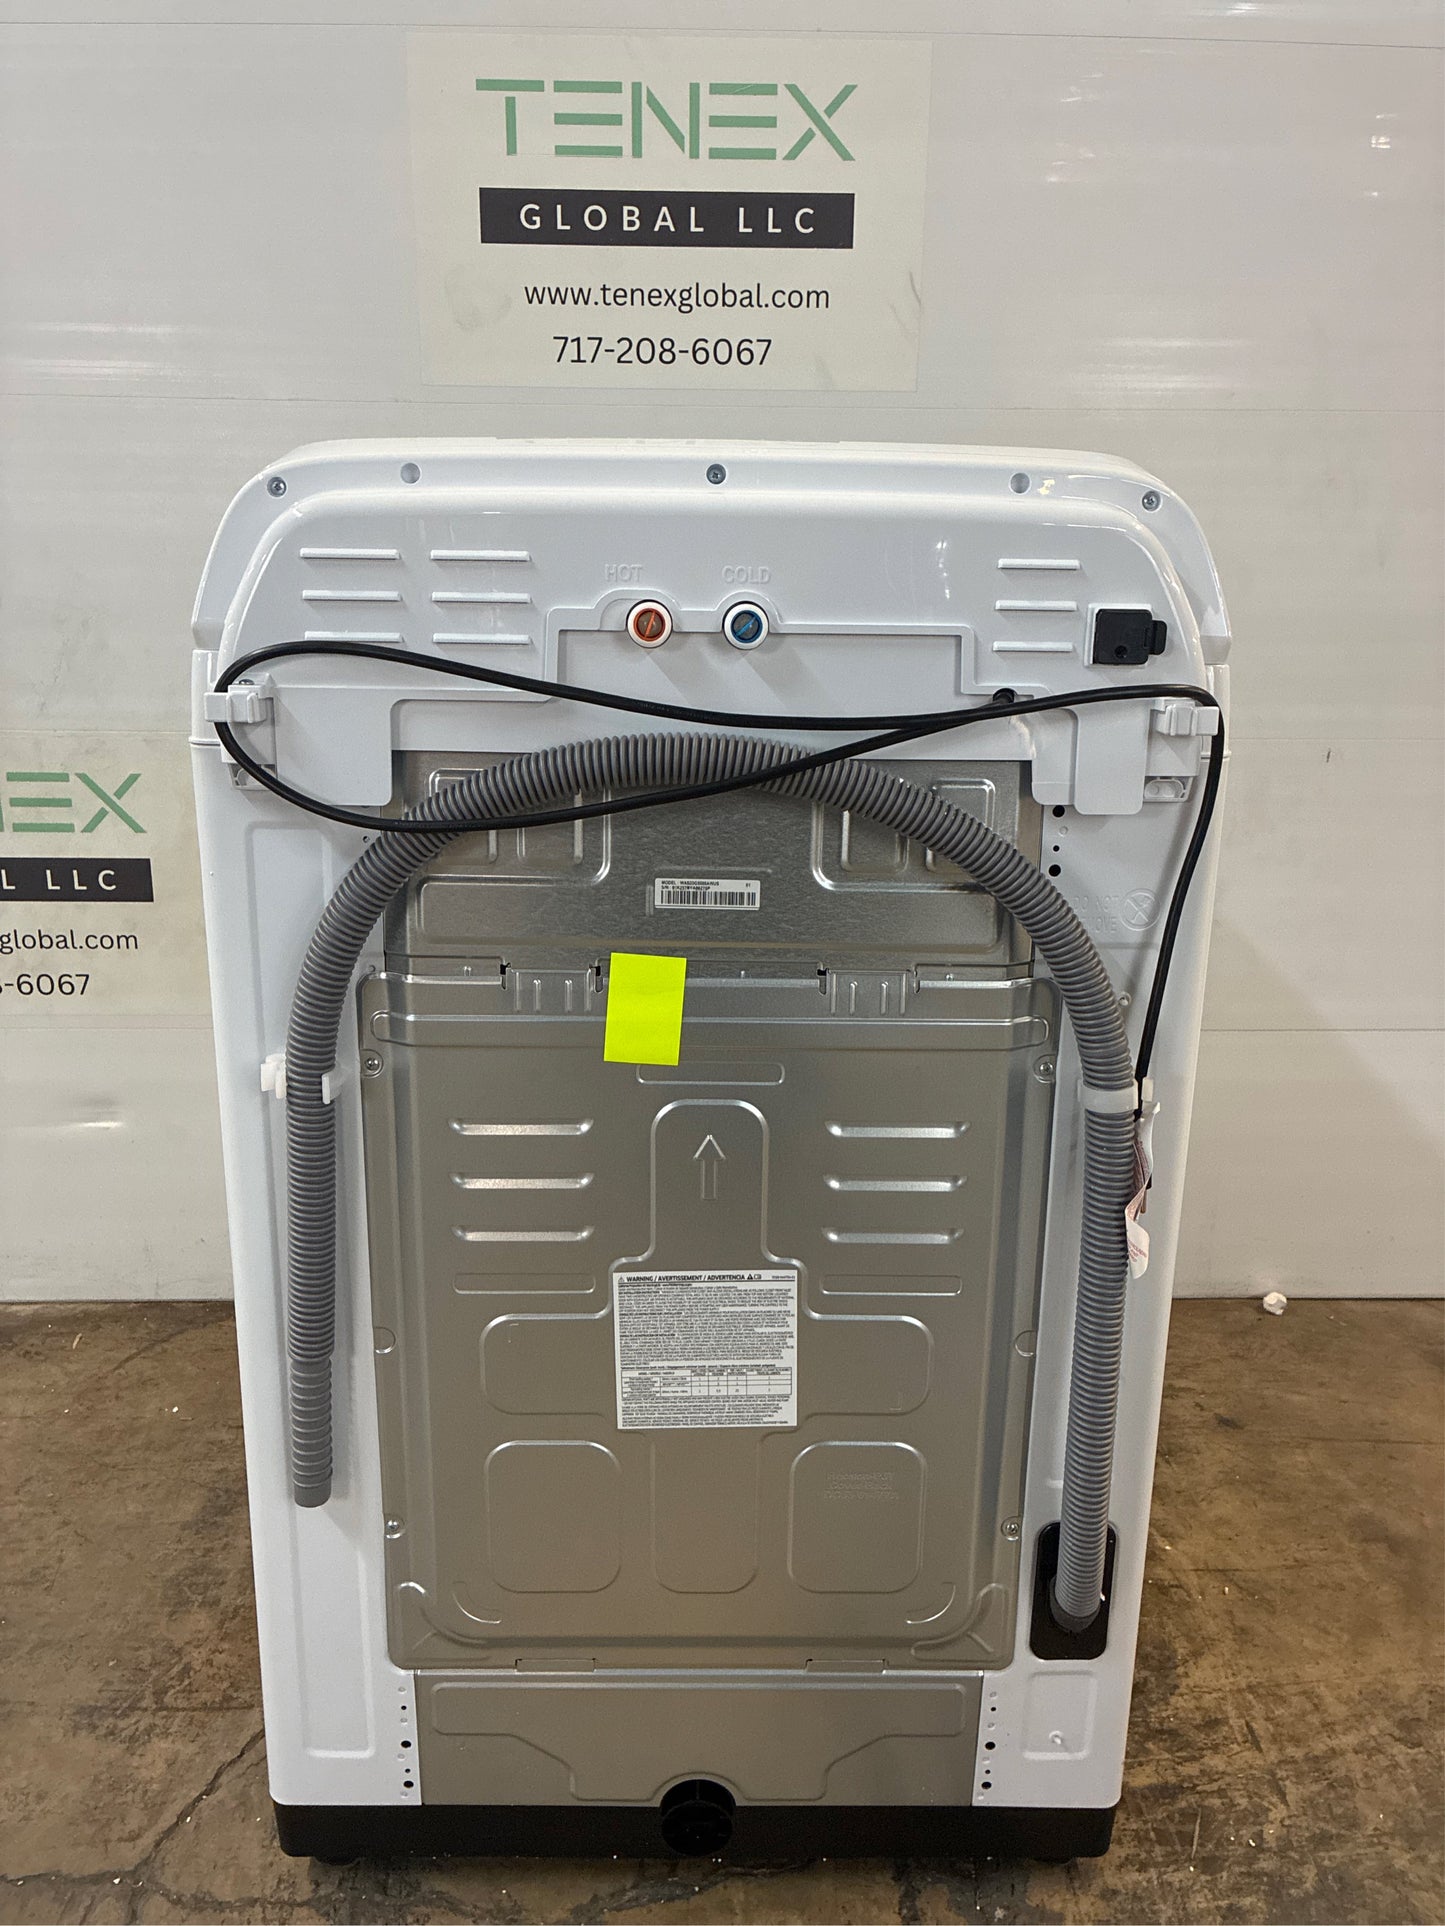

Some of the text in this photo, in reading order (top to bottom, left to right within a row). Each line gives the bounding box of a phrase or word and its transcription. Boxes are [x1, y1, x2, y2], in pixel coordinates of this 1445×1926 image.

[476, 79, 857, 161] TENEX
[519, 203, 815, 235] GLOBAL LLC
[524, 282, 830, 314] www.tenexglobal.com
[552, 336, 772, 366] 717-208-6067
[604, 564, 642, 582] HOT
[721, 566, 771, 584] COLD
[0, 771, 147, 833] EX
[45, 869, 117, 891] LLC
[0, 973, 90, 996] -6067
